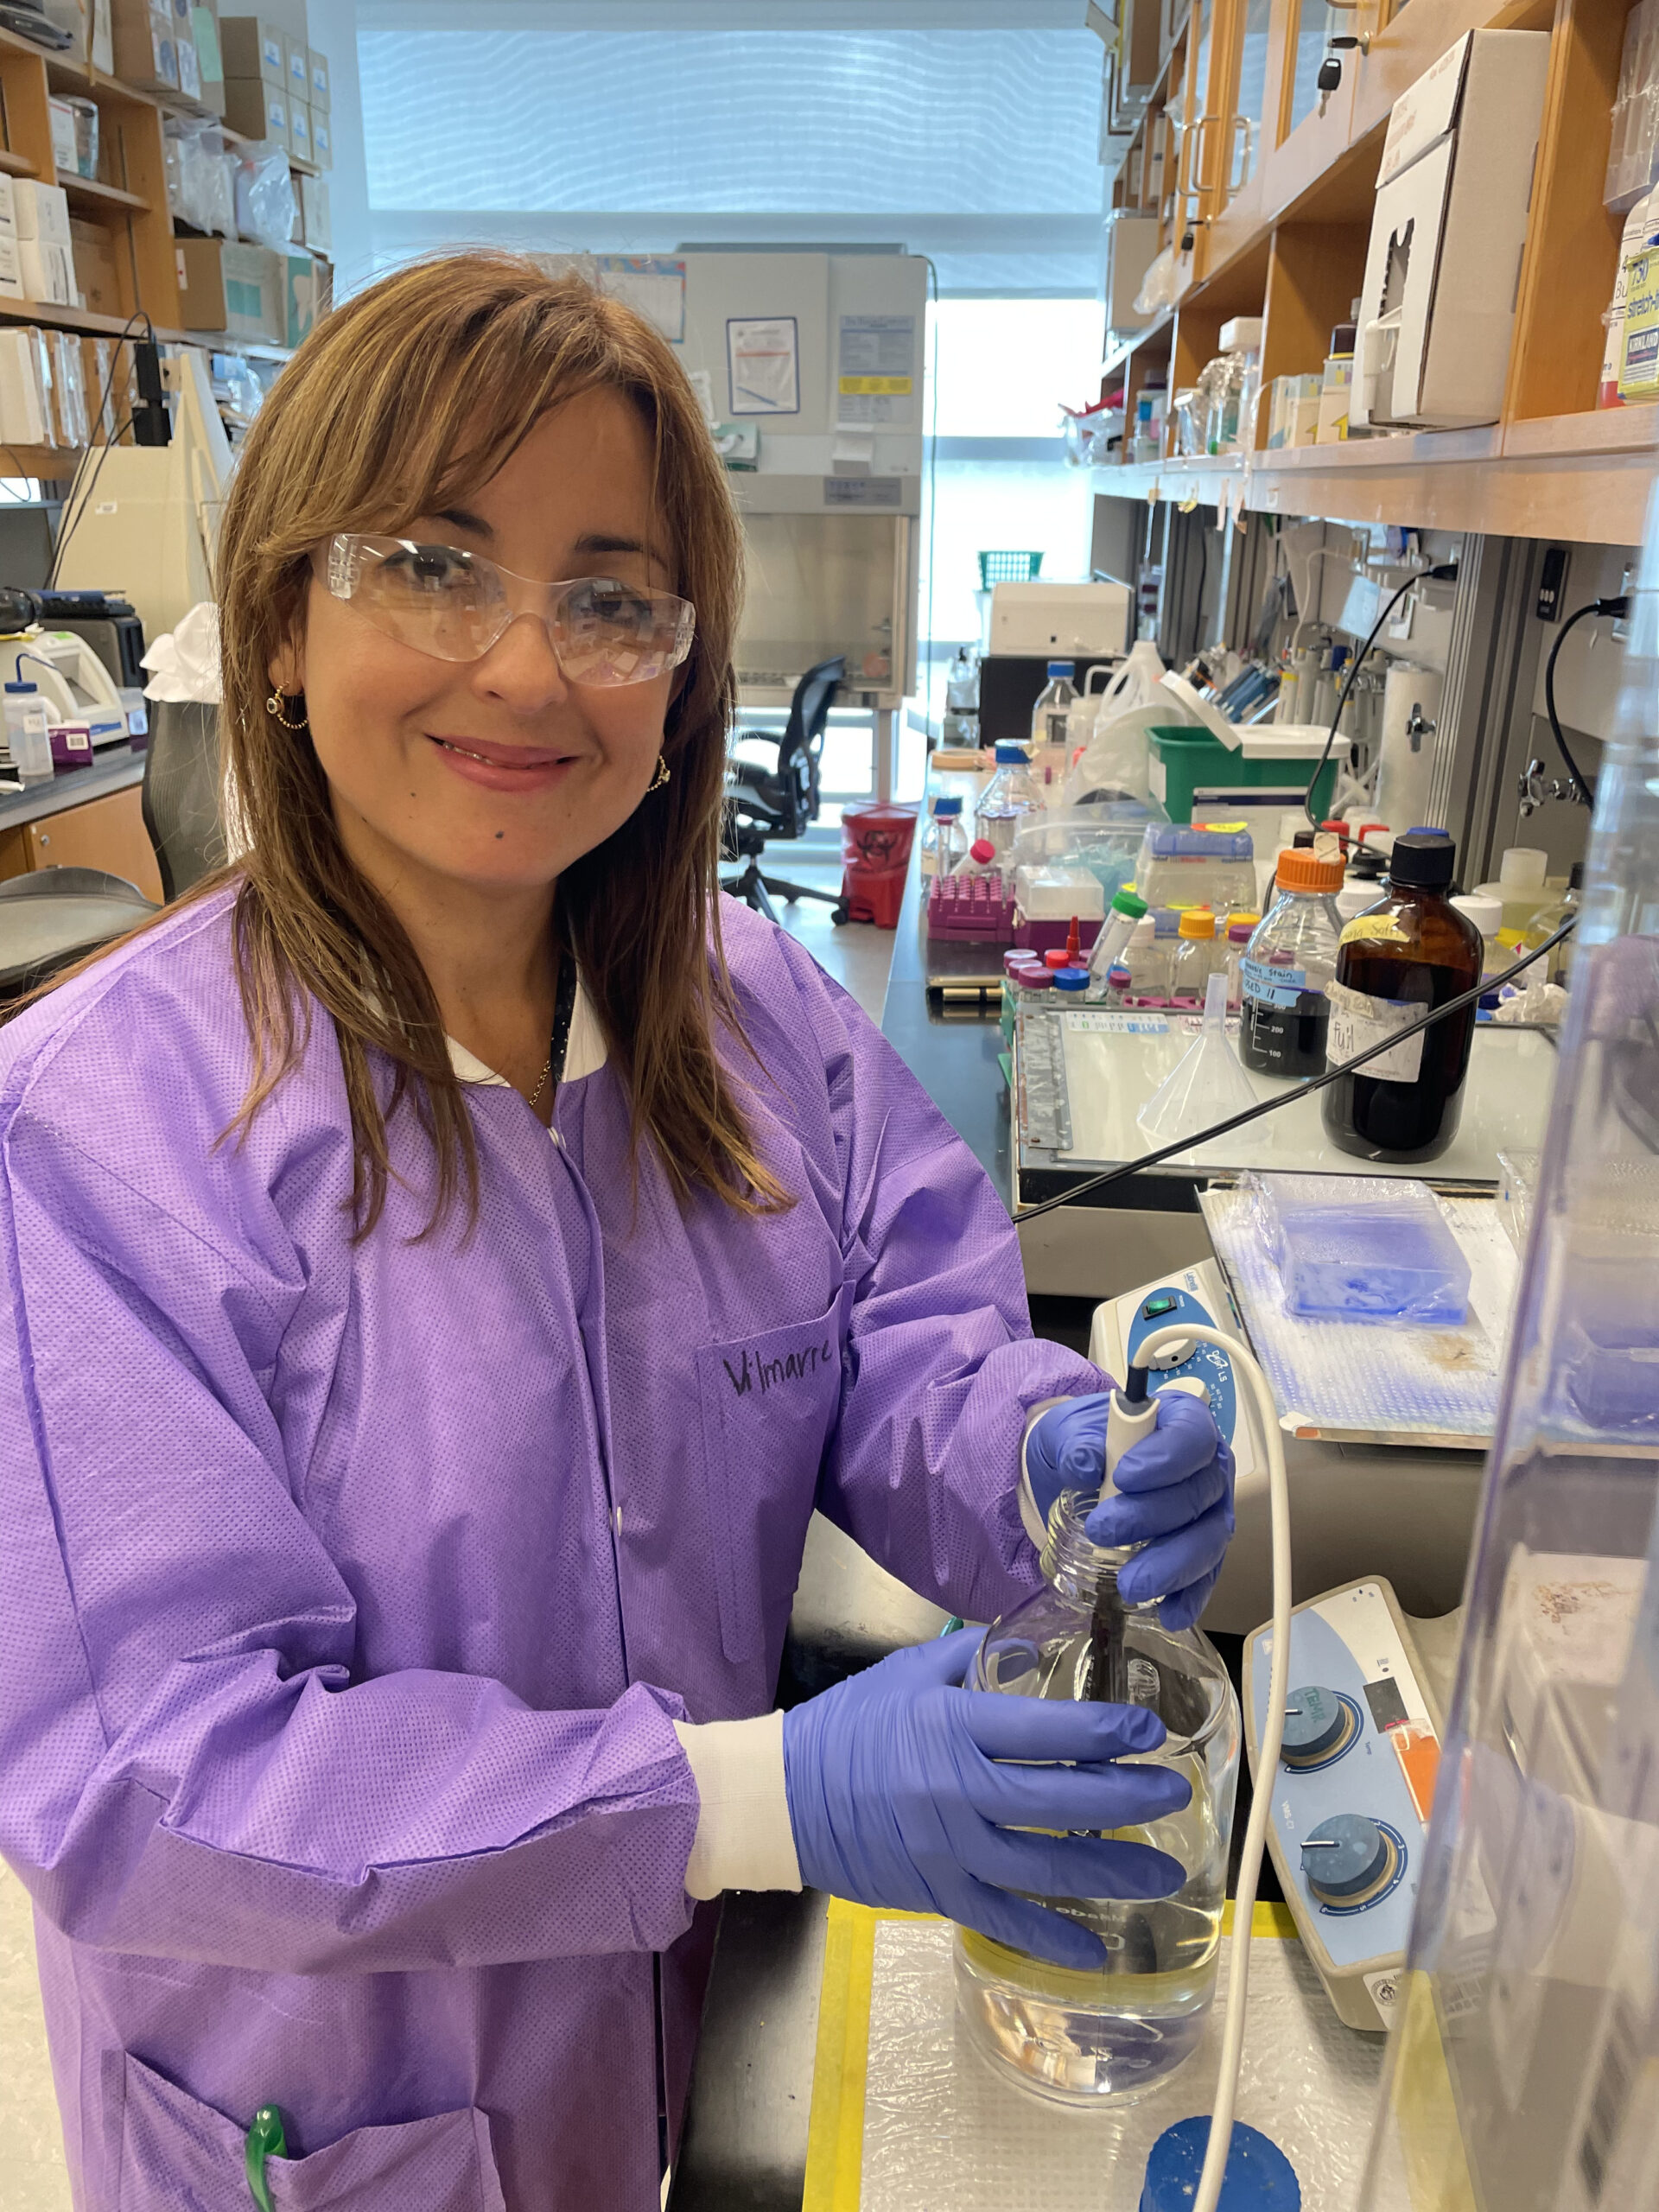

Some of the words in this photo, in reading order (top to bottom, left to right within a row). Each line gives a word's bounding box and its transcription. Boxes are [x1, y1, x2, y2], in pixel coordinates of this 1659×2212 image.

[1270, 1024, 1285, 1035] 200
[1268, 1049, 1282, 1058] 100
[1217, 1370, 1228, 1383] LS
